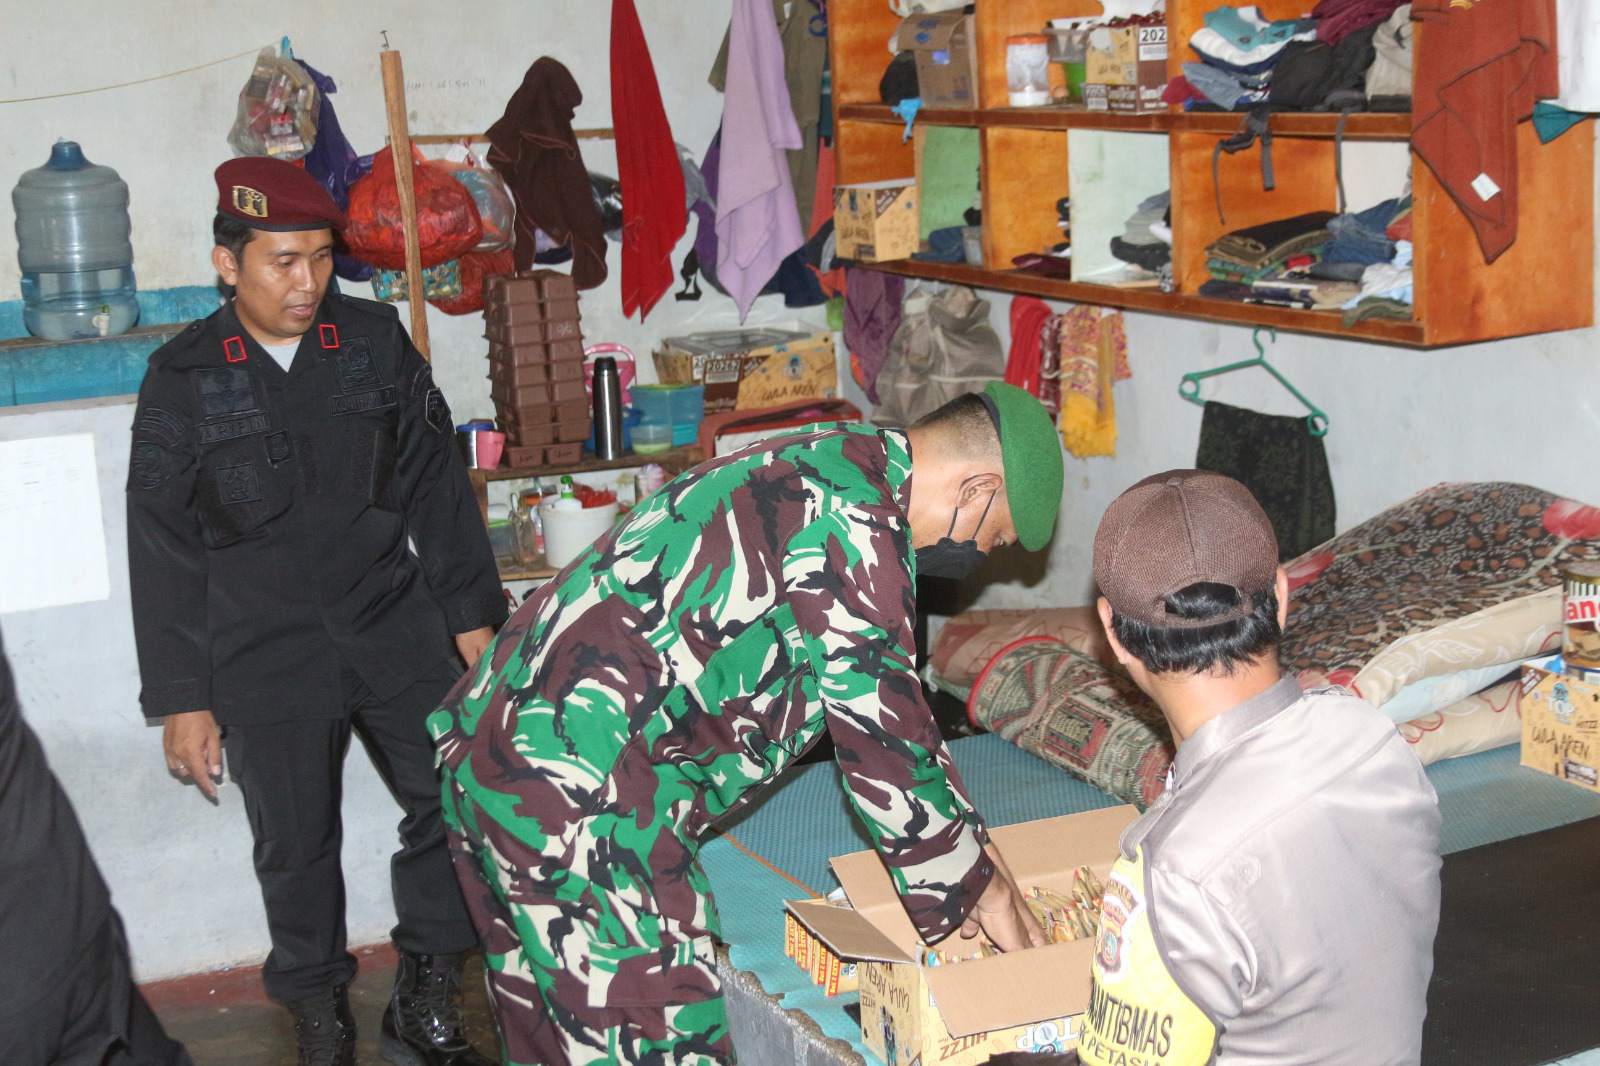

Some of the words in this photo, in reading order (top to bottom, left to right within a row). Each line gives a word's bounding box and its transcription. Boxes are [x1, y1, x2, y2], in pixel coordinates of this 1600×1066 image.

[888, 982, 910, 1013] GULA
[939, 1032, 988, 1062] HITZZ
[1016, 1017, 1080, 1050] TOP
